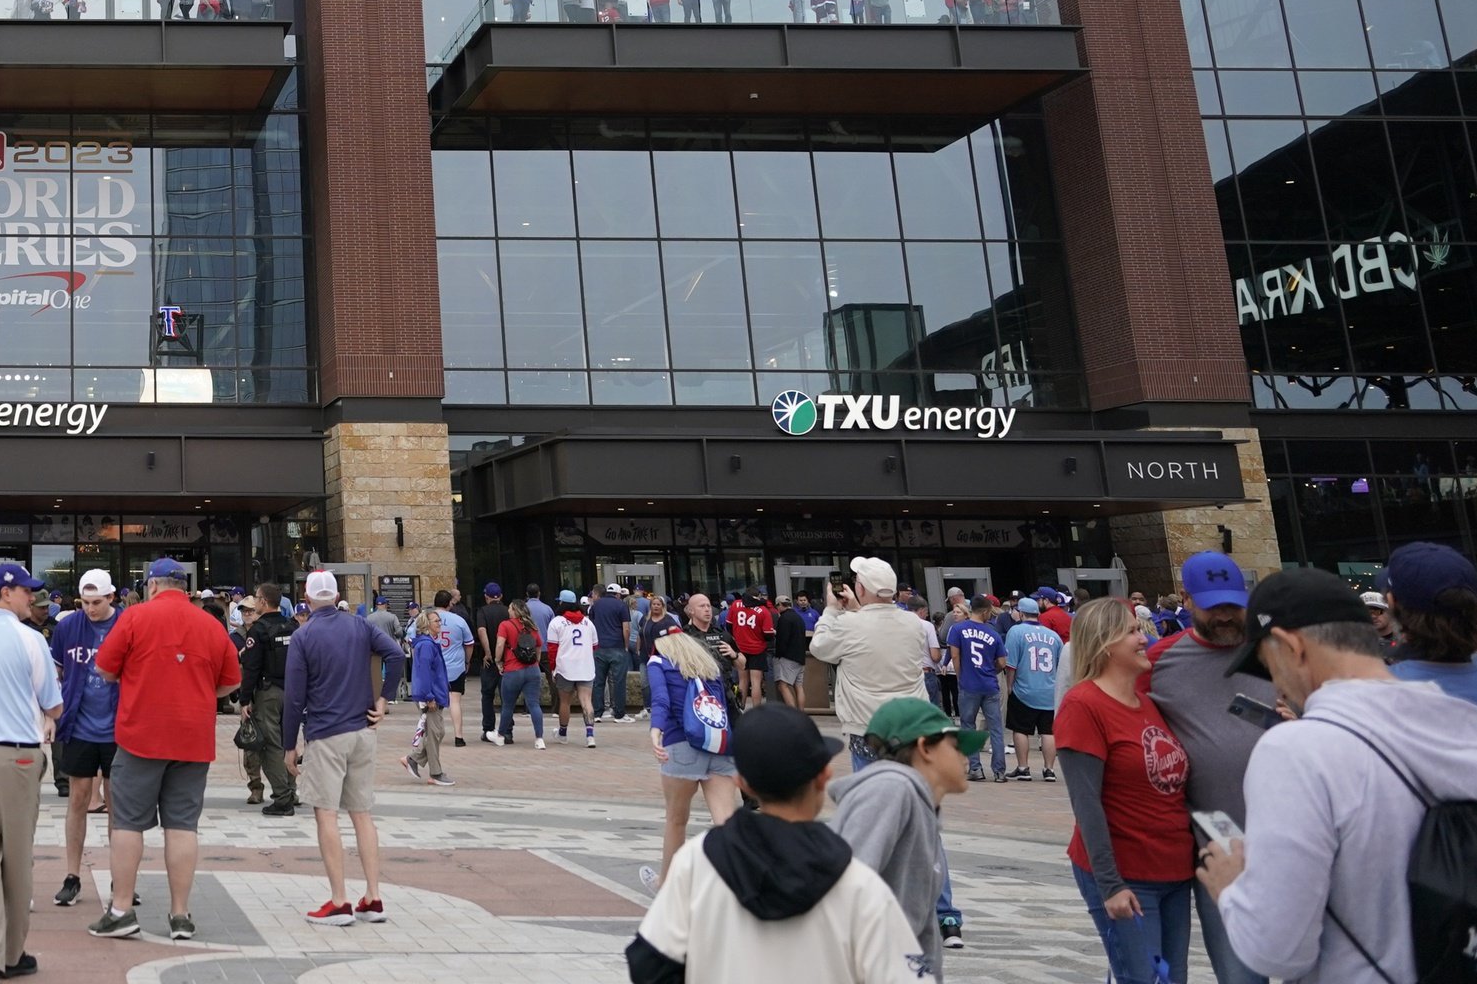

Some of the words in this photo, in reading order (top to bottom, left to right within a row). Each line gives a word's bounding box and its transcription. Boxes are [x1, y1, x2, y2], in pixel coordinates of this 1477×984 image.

[13, 140, 134, 164] 2023
[817, 394, 900, 430] TXU
[904, 407, 1017, 439] energy
[1126, 461, 1220, 480] NORTH
[605, 527, 617, 541] GO
[956, 529, 969, 543] GO
[736, 601, 764, 615] FIER
[561, 619, 589, 628] SEEN
[736, 610, 757, 630] 84
[572, 628, 584, 646] 2
[961, 628, 996, 646] SEAGER
[1024, 632, 1055, 646] GALLO
[970, 641, 984, 666] 5
[1027, 645, 1054, 673] 13
